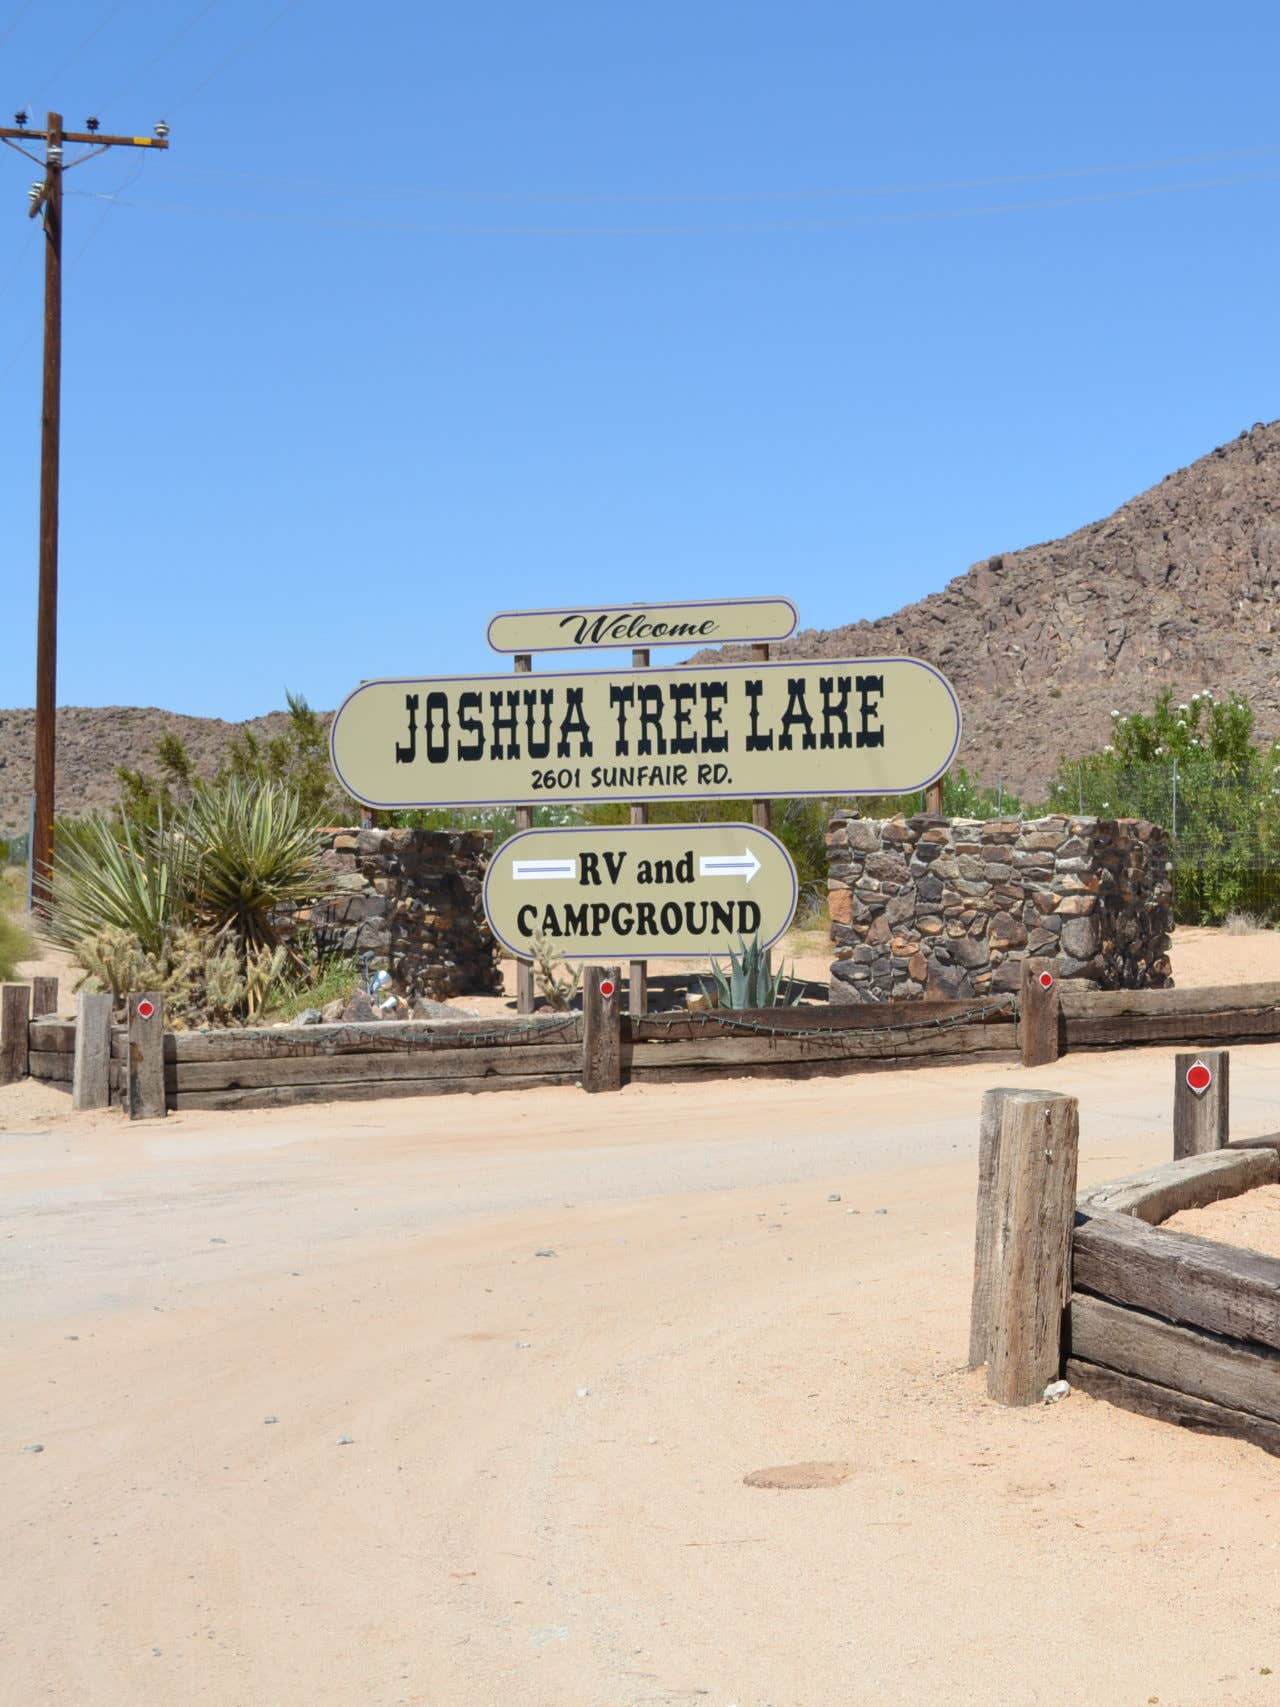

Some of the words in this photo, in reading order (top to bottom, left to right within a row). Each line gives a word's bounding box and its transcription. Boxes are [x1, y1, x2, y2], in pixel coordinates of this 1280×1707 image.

[559, 613, 719, 645] Welcome
[395, 687, 594, 764] JOSHUA
[609, 681, 729, 757] TREE
[744, 674, 885, 752] LAKE
[531, 768, 581, 790] 2601
[590, 764, 688, 788] SUNFAIR
[697, 763, 733, 785] RD.
[578, 851, 628, 886] RV
[636, 850, 695, 885] and
[516, 900, 762, 937] CAMPGROUND
